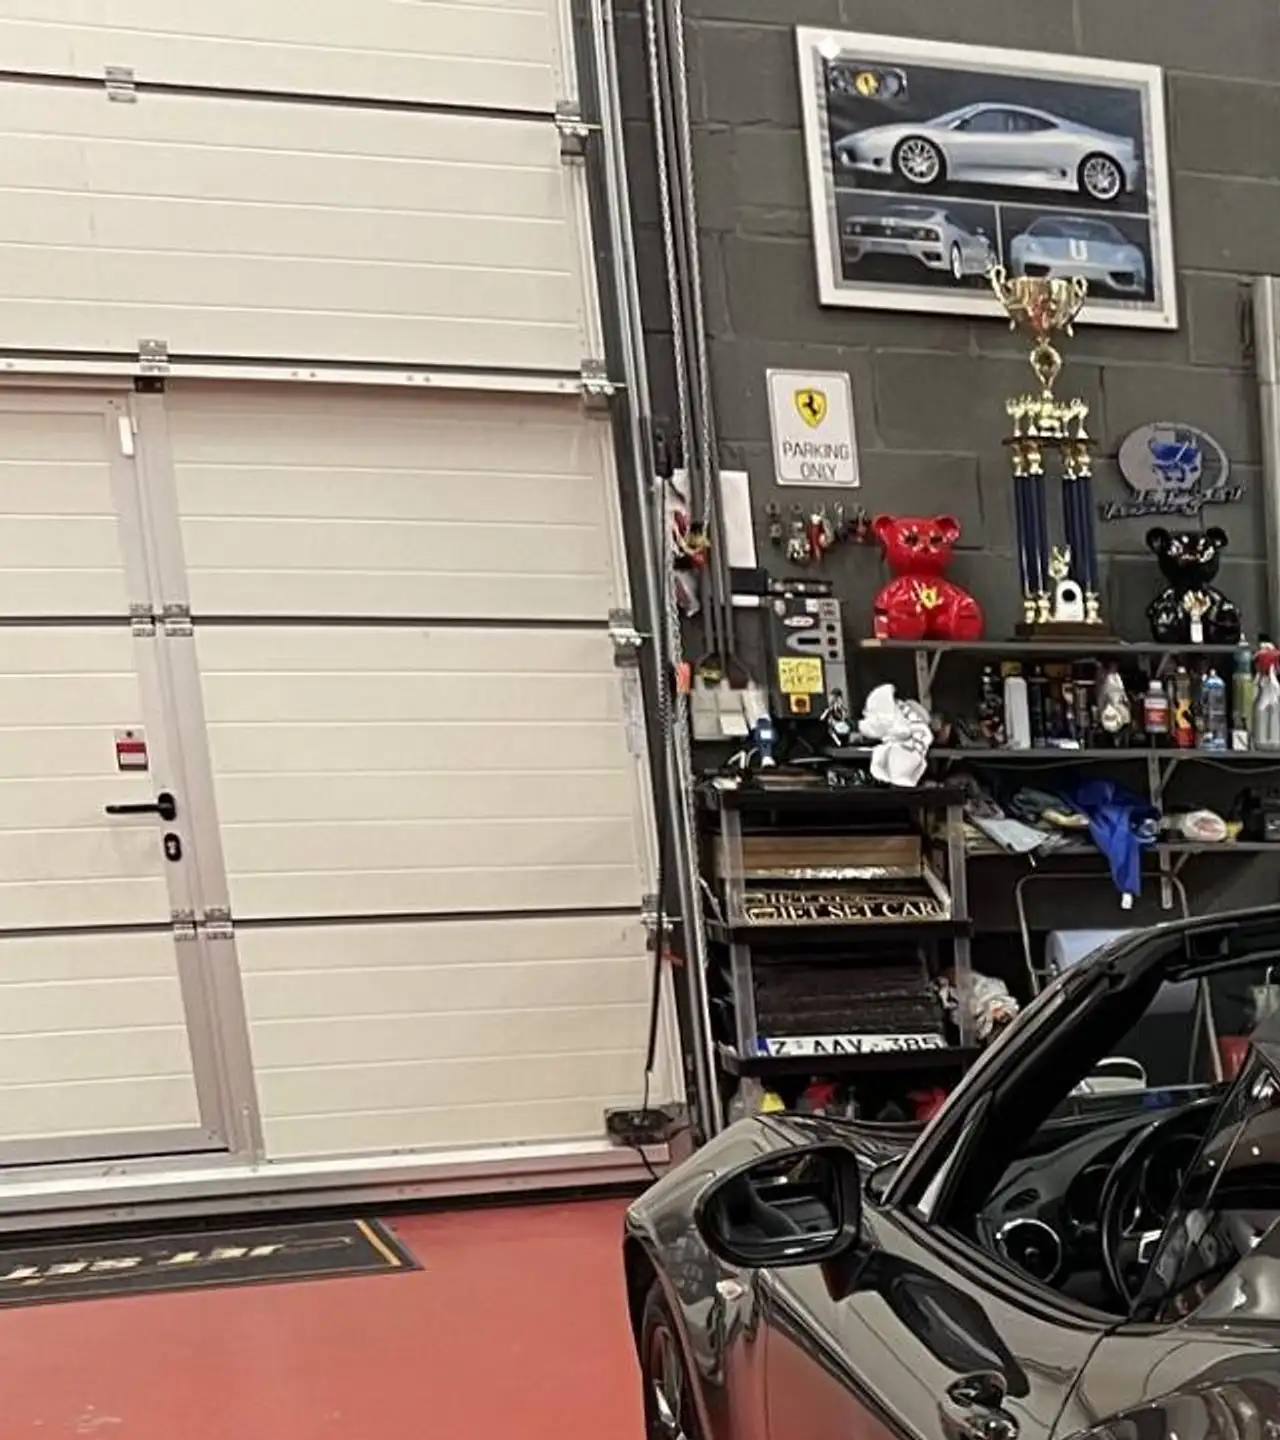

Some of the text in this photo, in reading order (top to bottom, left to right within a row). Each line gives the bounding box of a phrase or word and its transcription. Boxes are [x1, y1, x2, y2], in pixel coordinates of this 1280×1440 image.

[782, 441, 850, 461] PARKING
[800, 461, 837, 480] ONLY
[828, 903, 873, 919] SET
